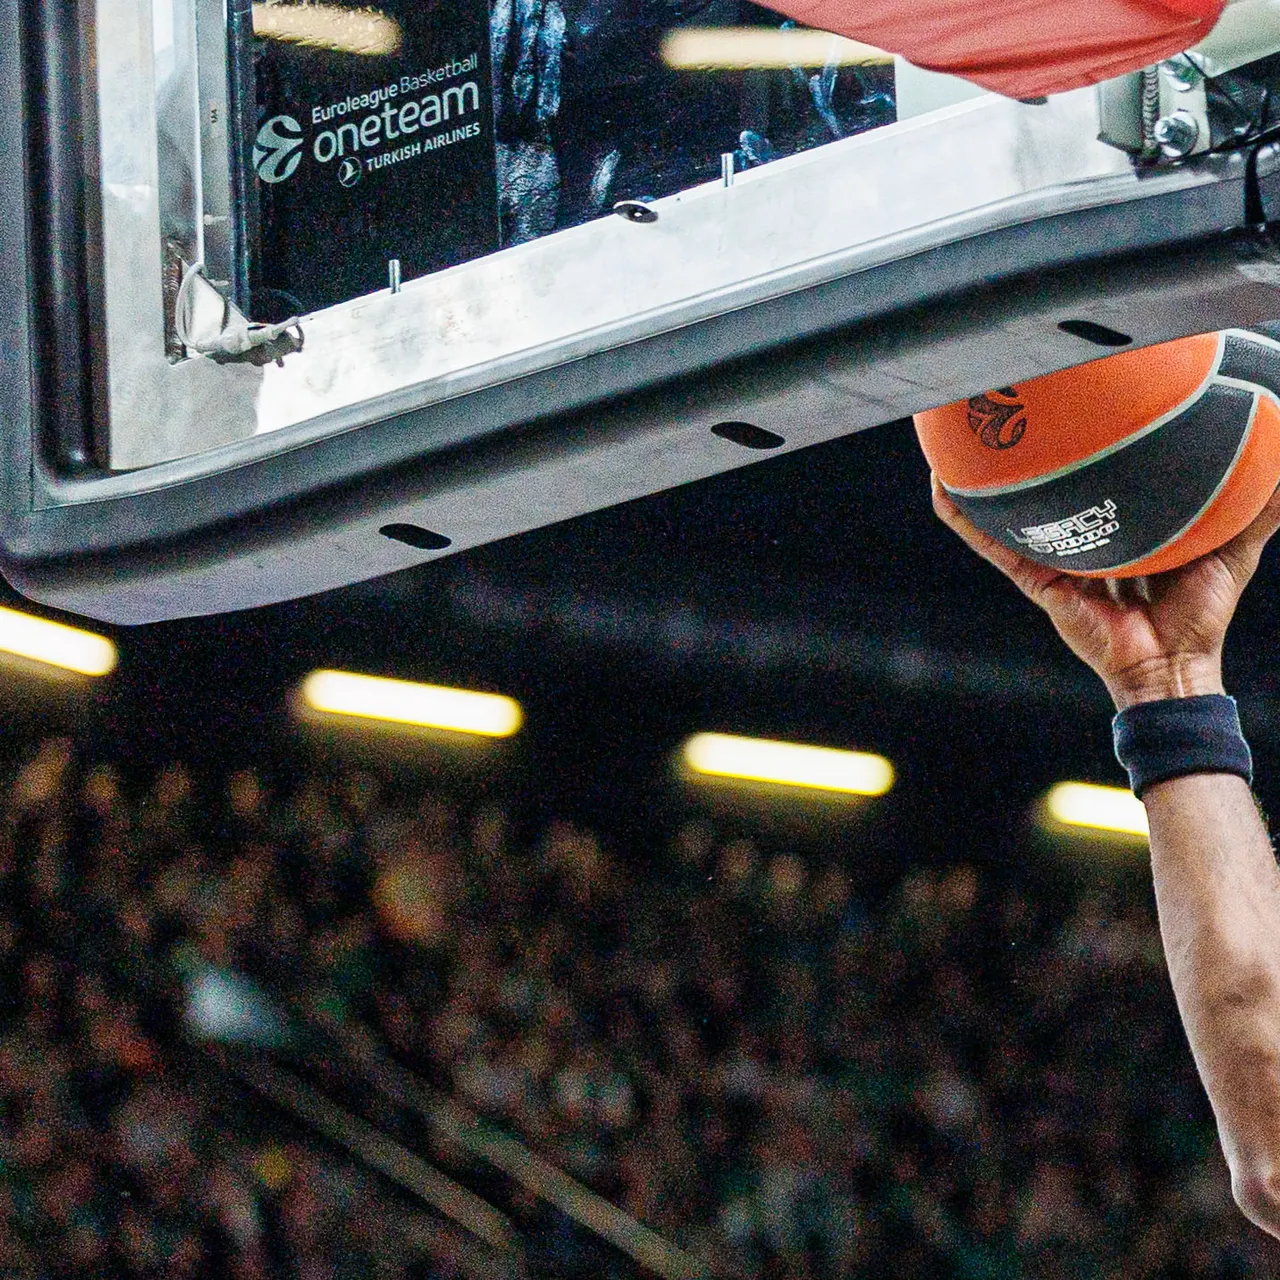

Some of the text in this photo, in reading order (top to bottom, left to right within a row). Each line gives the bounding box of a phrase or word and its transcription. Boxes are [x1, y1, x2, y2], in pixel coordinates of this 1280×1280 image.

[312, 53, 478, 124] Euroleague Basketball
[313, 81, 480, 163] oneteam
[366, 122, 482, 172] TURKISH AIRLINES
